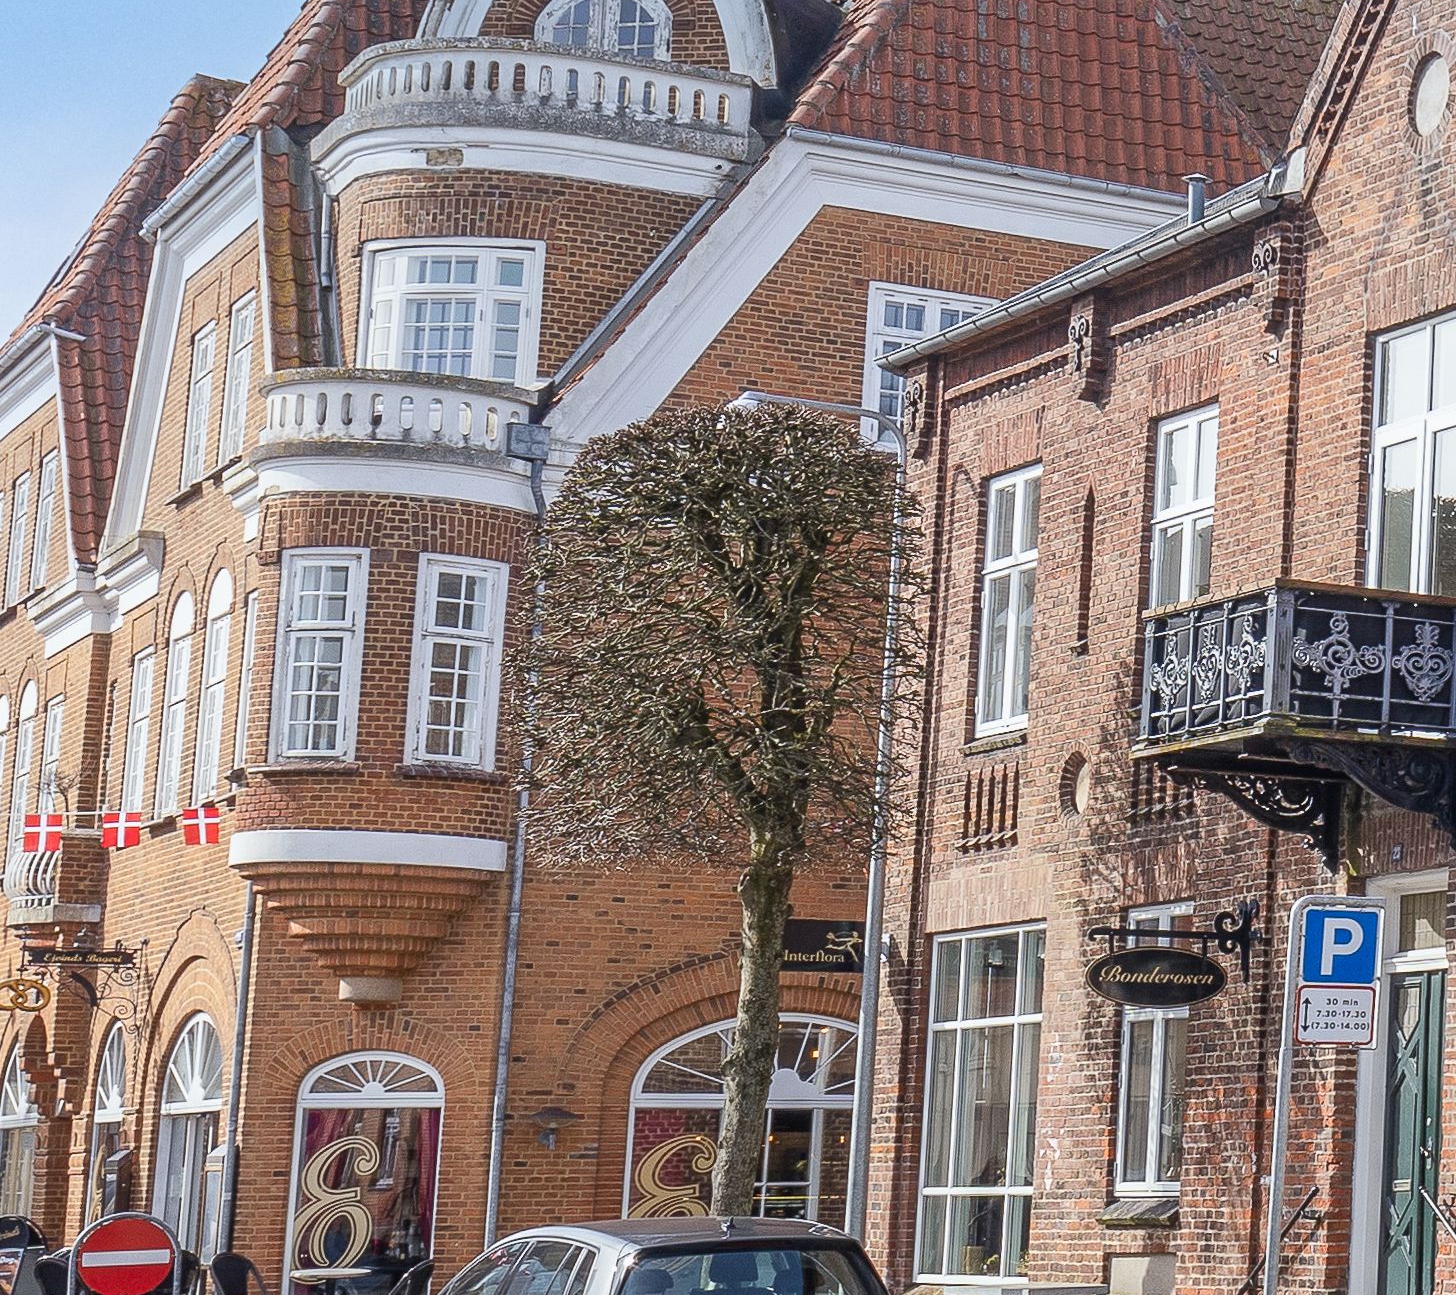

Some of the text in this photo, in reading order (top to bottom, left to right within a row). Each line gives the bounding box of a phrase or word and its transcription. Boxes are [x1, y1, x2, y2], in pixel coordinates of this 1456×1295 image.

[1320, 917, 1364, 976] P
[784, 949, 845, 963] Interflora
[1099, 965, 1214, 985] Bonderosen
[1326, 998, 1359, 1006] 30 min
